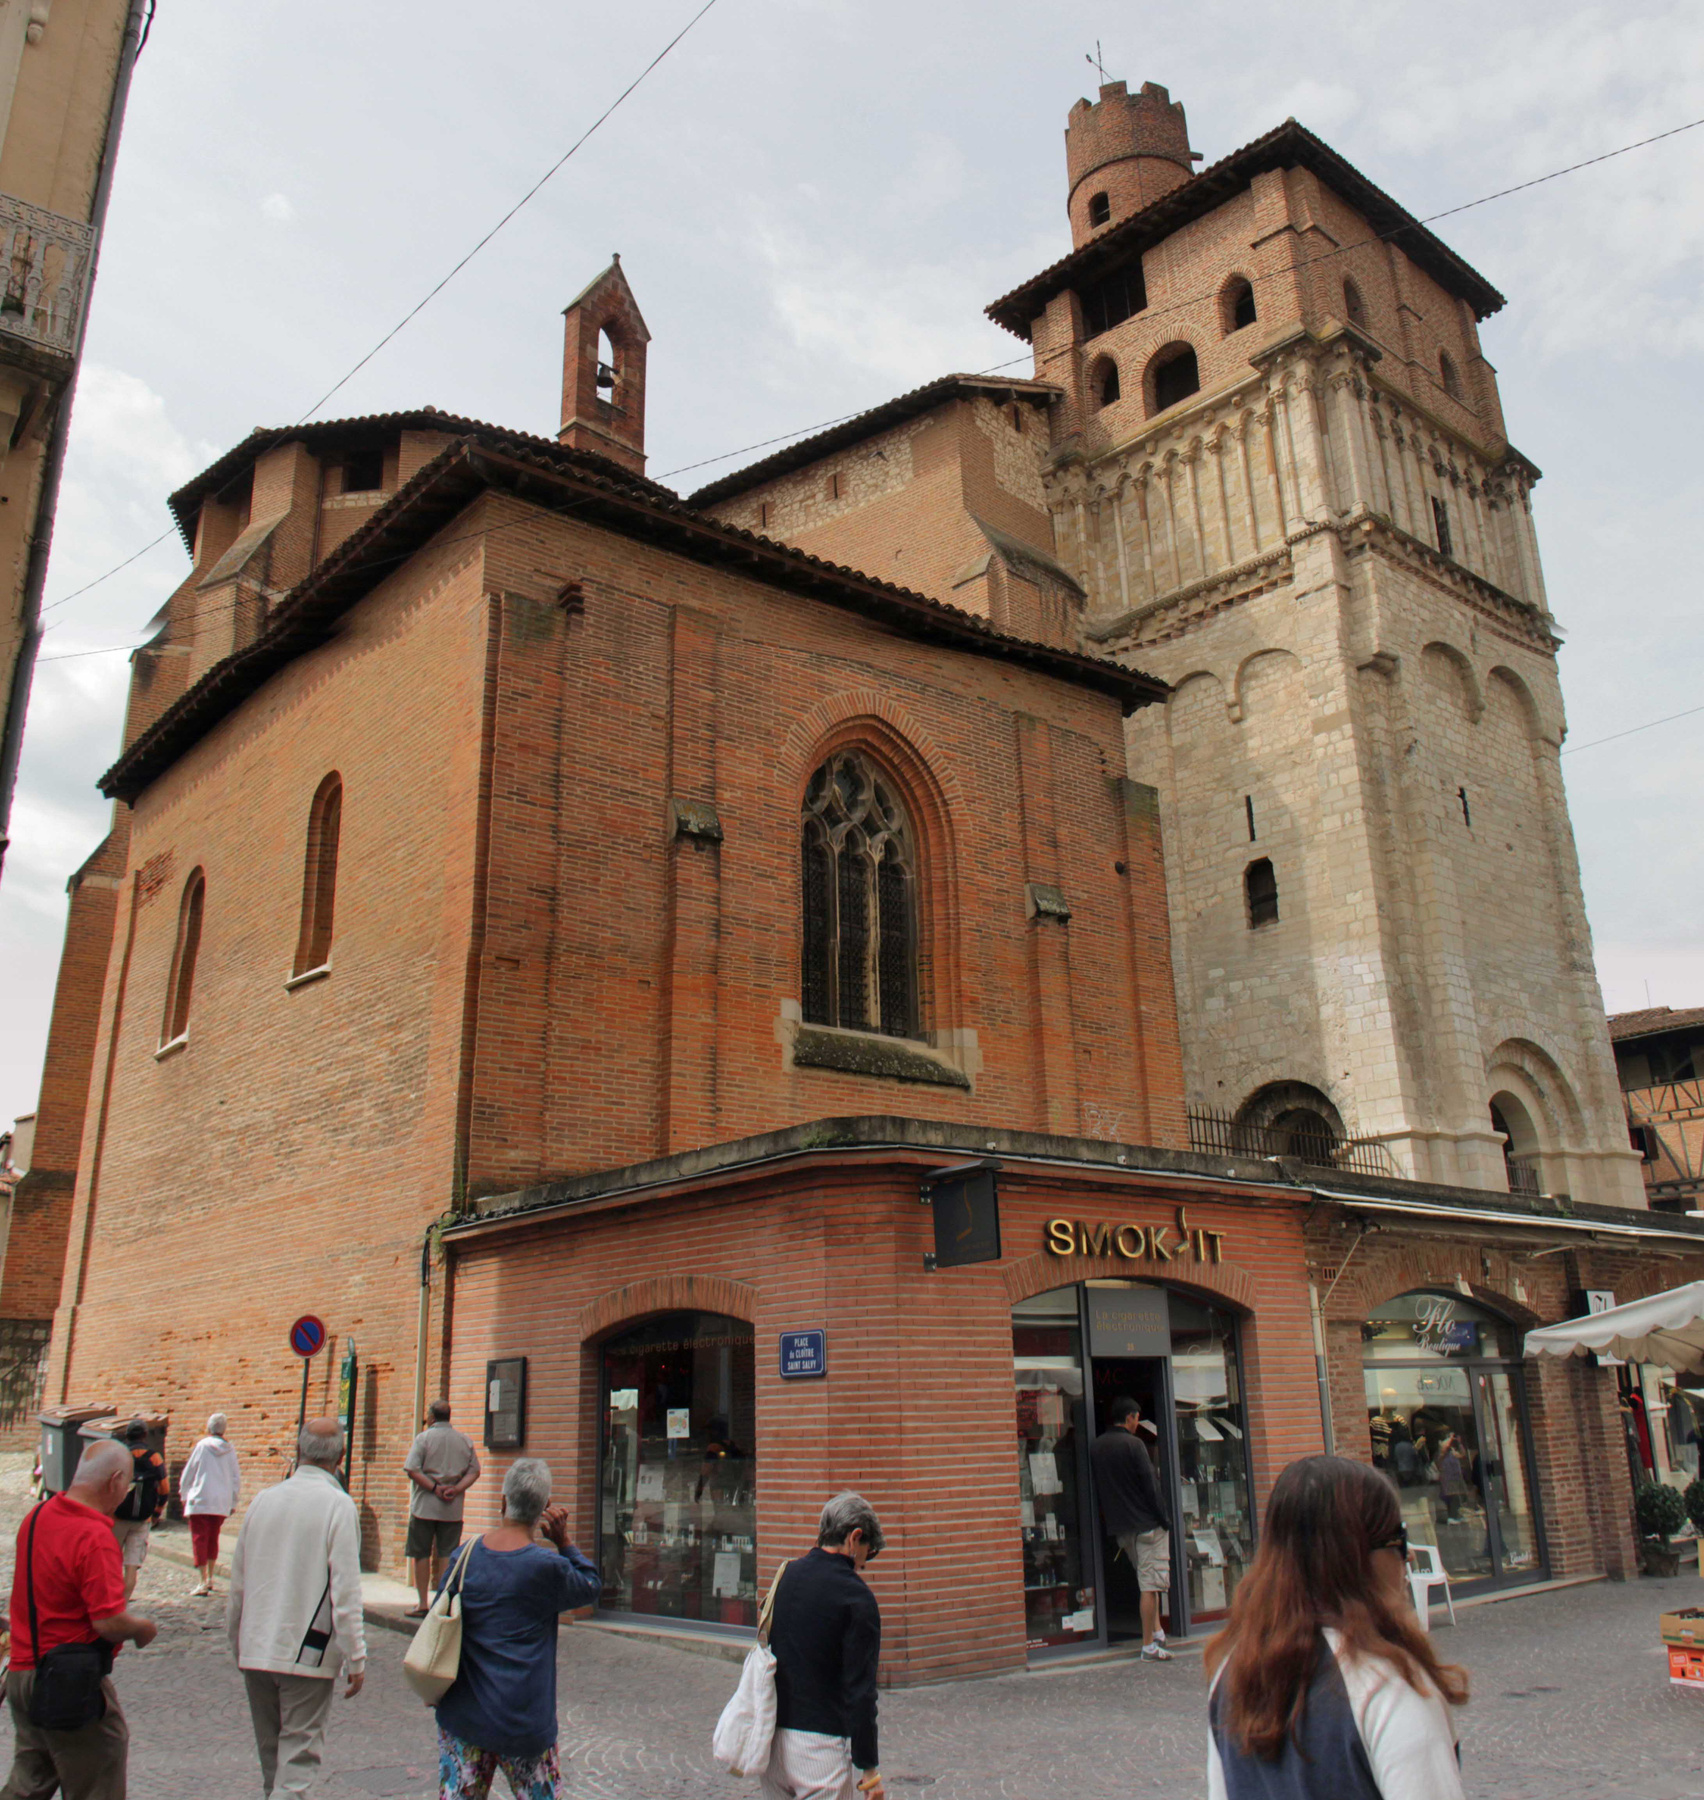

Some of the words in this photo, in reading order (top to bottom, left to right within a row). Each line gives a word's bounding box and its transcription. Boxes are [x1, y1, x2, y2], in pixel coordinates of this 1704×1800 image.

[1111, 1311, 1162, 1322] cigarette
[1412, 1295, 1456, 1334] Flo
[630, 1341, 679, 1356] cigarette
[794, 1337, 809, 1347] PLACE
[1416, 1333, 1461, 1358] Boutique
[787, 1361, 801, 1371] SAINT
[802, 1360, 816, 1370] SALVY
